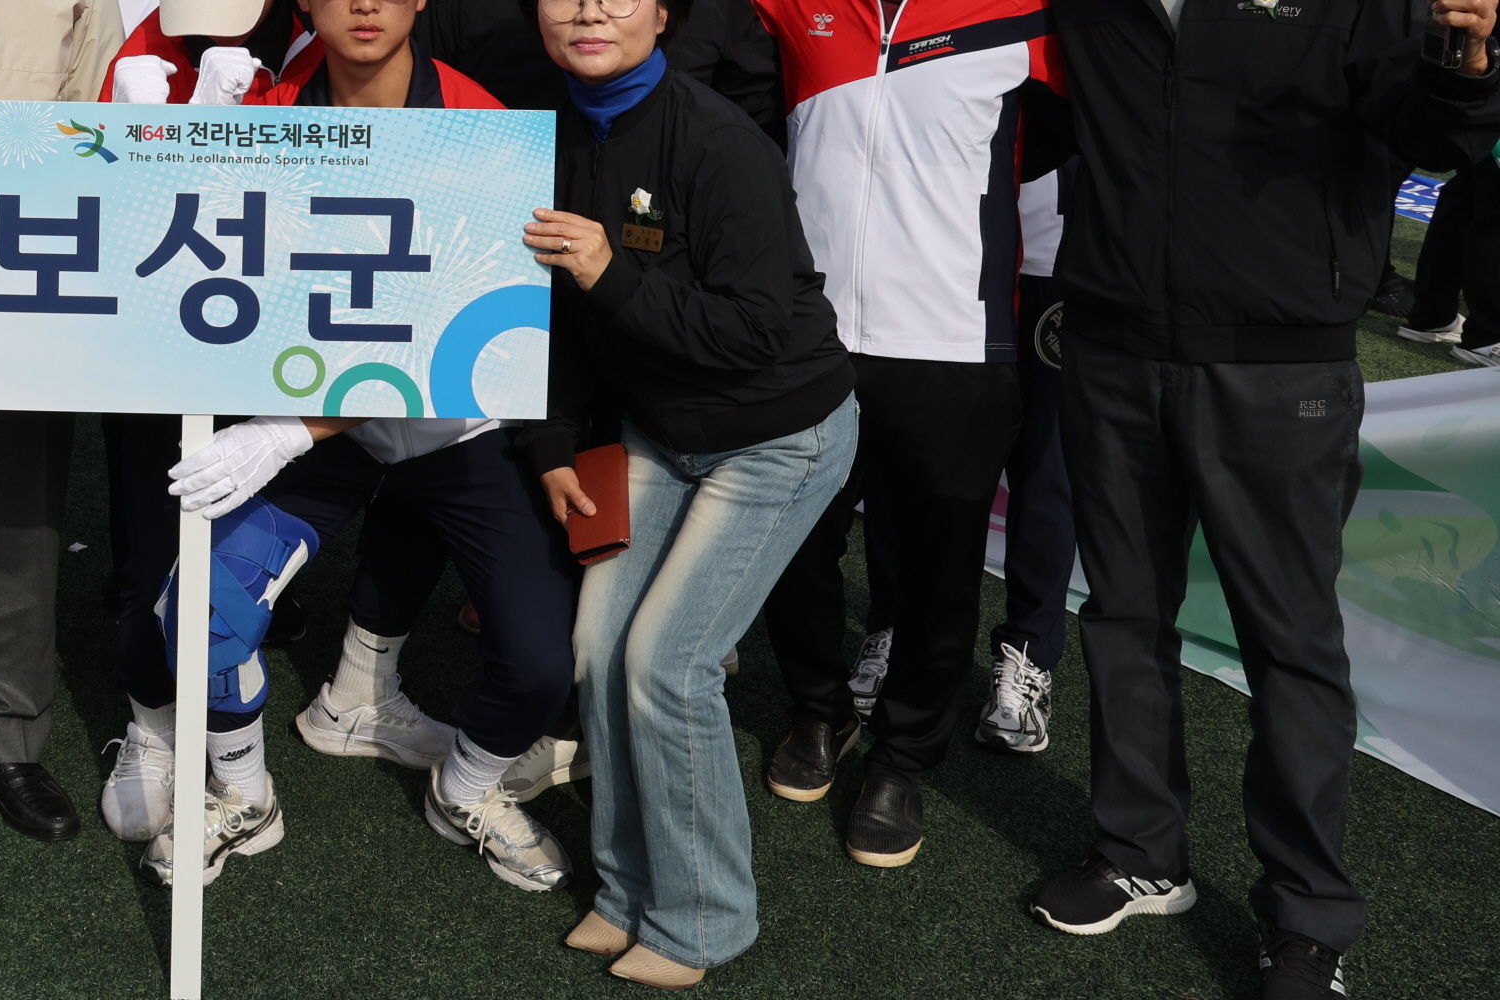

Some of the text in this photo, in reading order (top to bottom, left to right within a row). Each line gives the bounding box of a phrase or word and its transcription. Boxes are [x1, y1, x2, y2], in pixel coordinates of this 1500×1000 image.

[808, 28, 834, 37] hummel
[909, 34, 952, 51] DANISH
[125, 121, 372, 149] 제64회 전라남도체육대회
[128, 152, 369, 168] The 64th Jeollanamdo Sports Festival
[1299, 399, 1326, 409] RSC
